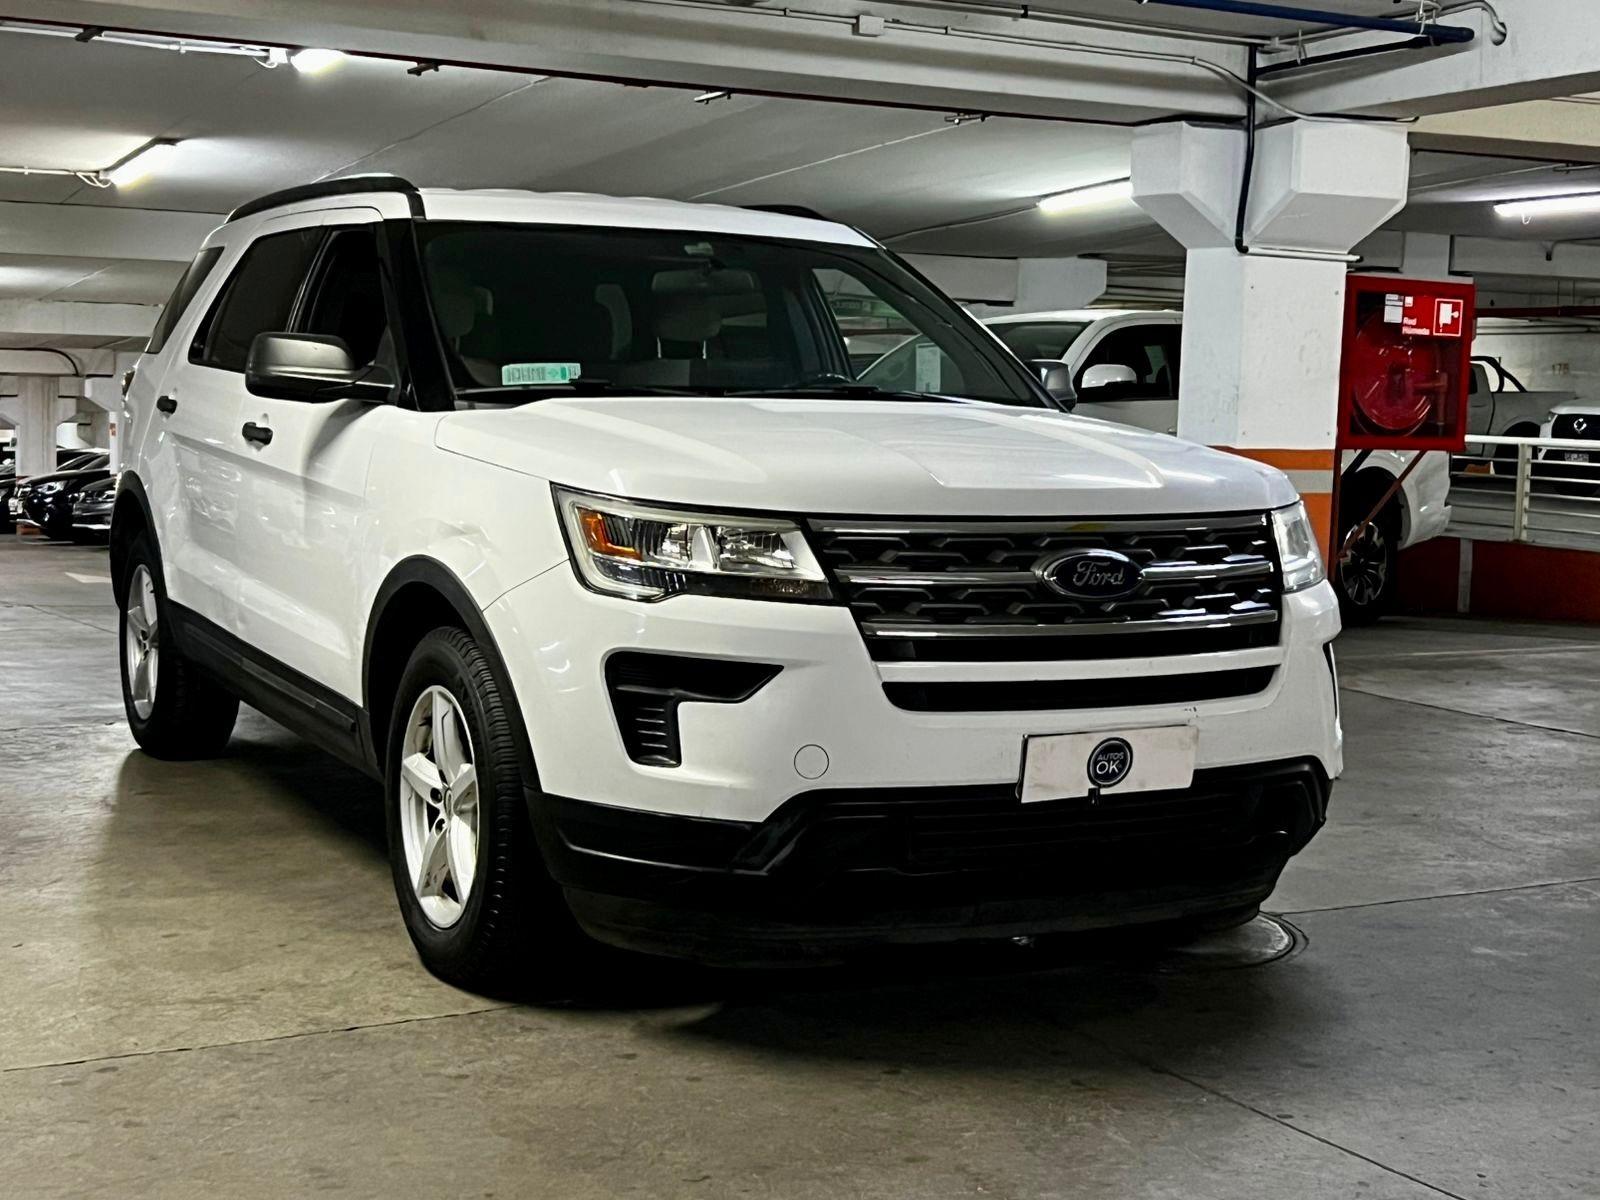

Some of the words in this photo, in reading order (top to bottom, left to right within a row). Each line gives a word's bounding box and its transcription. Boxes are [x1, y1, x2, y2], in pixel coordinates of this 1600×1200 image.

[1073, 560, 1125, 586] Ford
[1097, 752, 1124, 760] AUTOS
[1096, 760, 1119, 774] OK
